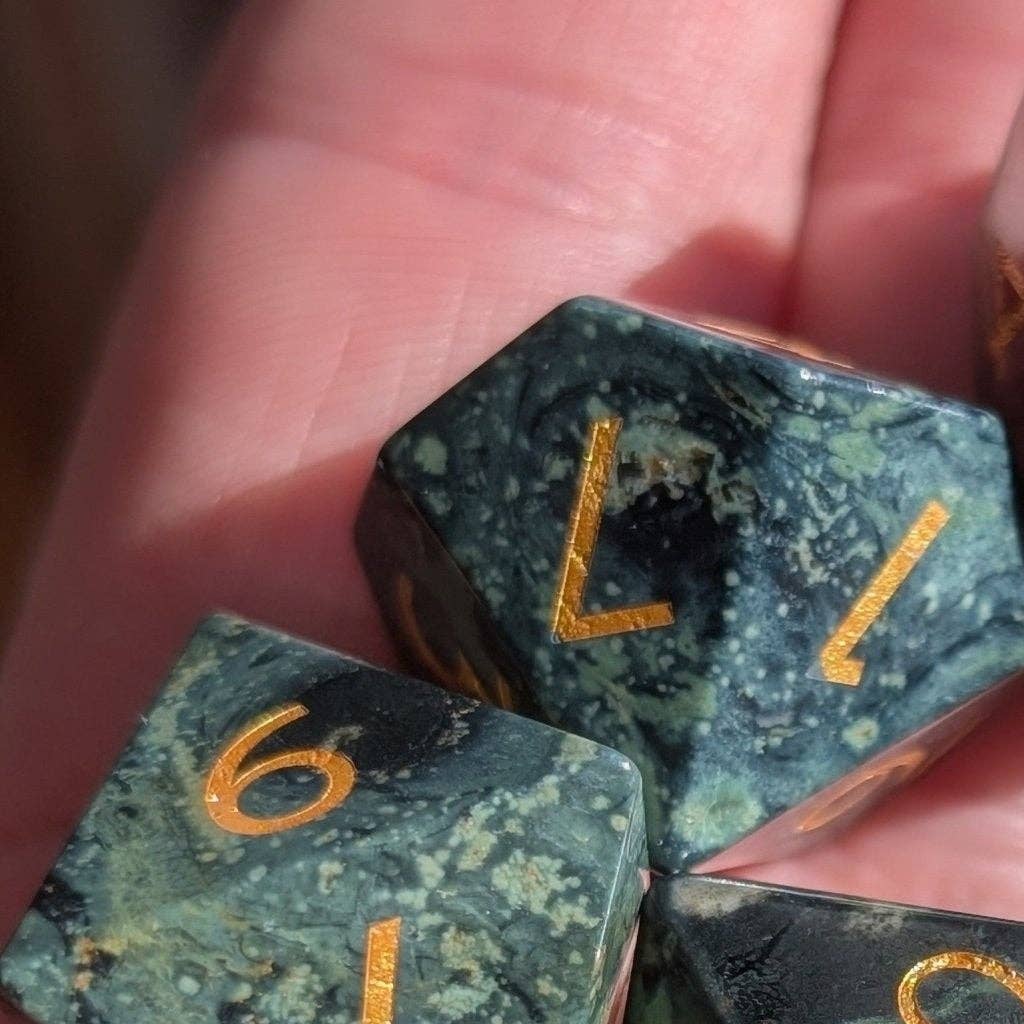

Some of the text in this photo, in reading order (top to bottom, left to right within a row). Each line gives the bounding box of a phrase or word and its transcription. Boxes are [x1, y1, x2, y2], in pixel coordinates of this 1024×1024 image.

[552, 417, 674, 642] 7
[820, 500, 951, 687] 1
[205, 703, 358, 836] 6
